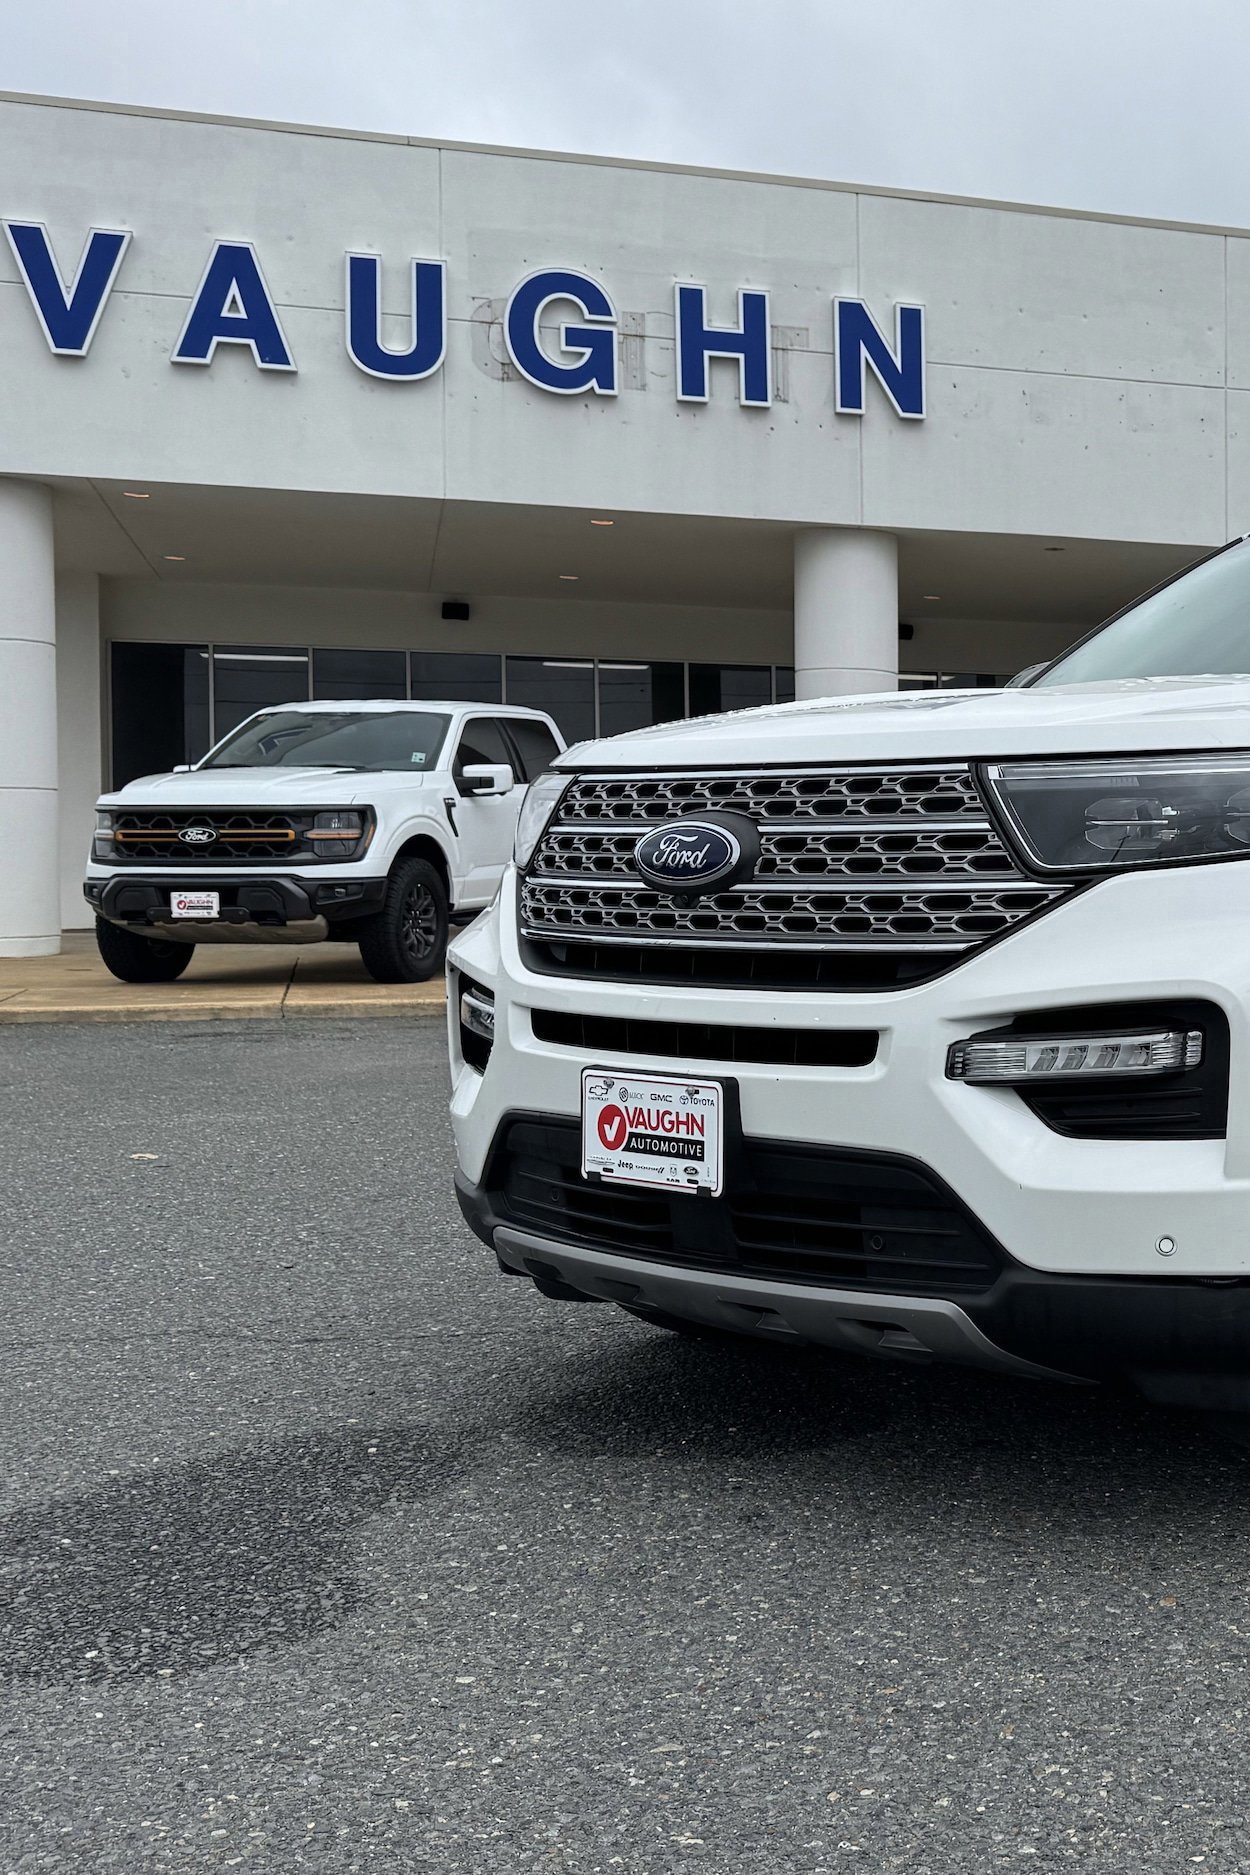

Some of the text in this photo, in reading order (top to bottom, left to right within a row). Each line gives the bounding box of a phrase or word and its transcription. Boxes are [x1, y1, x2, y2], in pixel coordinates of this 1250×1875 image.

[3, 218, 927, 420] VAUGHN
[185, 830, 208, 840] Ford
[652, 834, 710, 868] Ford
[650, 1093, 673, 1103] GMC
[689, 1097, 715, 1107] TOYOTA
[624, 1105, 705, 1137] VAUGHN
[630, 1137, 703, 1157] AUTOMOTIVE
[617, 1160, 633, 1172] Jeep
